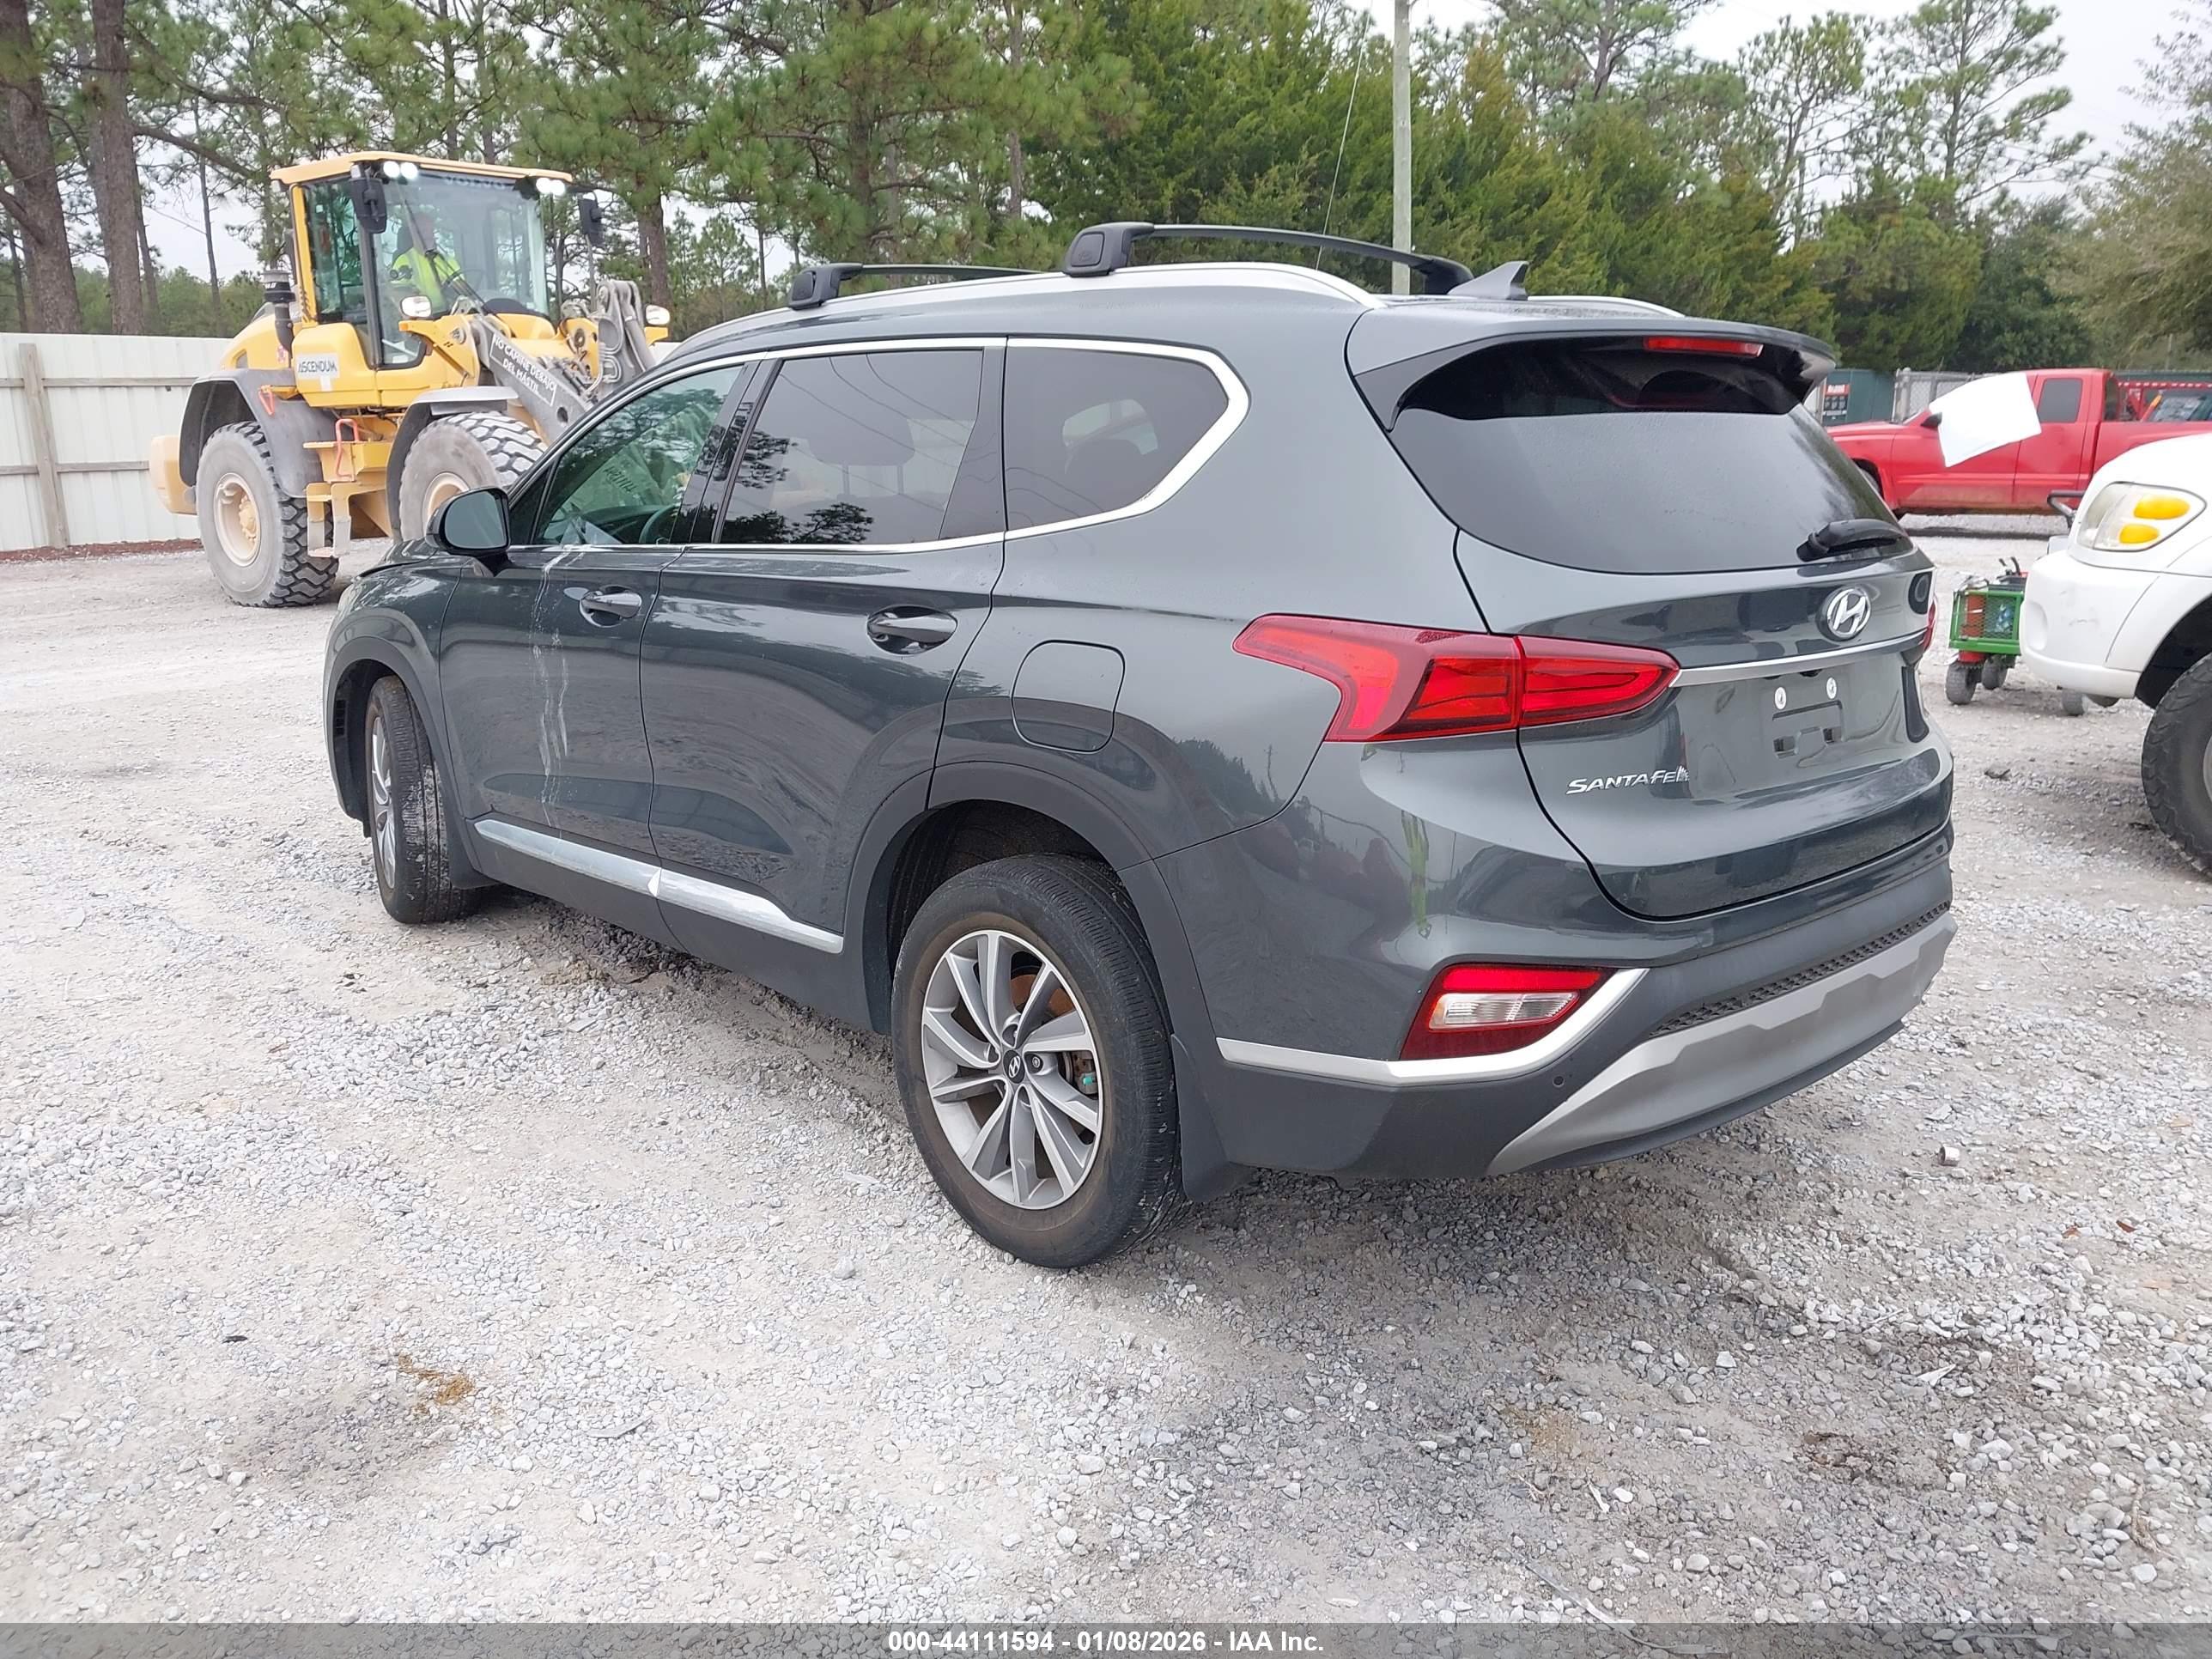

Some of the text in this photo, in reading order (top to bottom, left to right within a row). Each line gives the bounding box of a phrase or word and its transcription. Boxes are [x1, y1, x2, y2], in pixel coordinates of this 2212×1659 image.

[502, 358, 515, 374] DEL
[504, 343, 531, 370] CAMINE
[530, 365, 555, 391] DEBAJO
